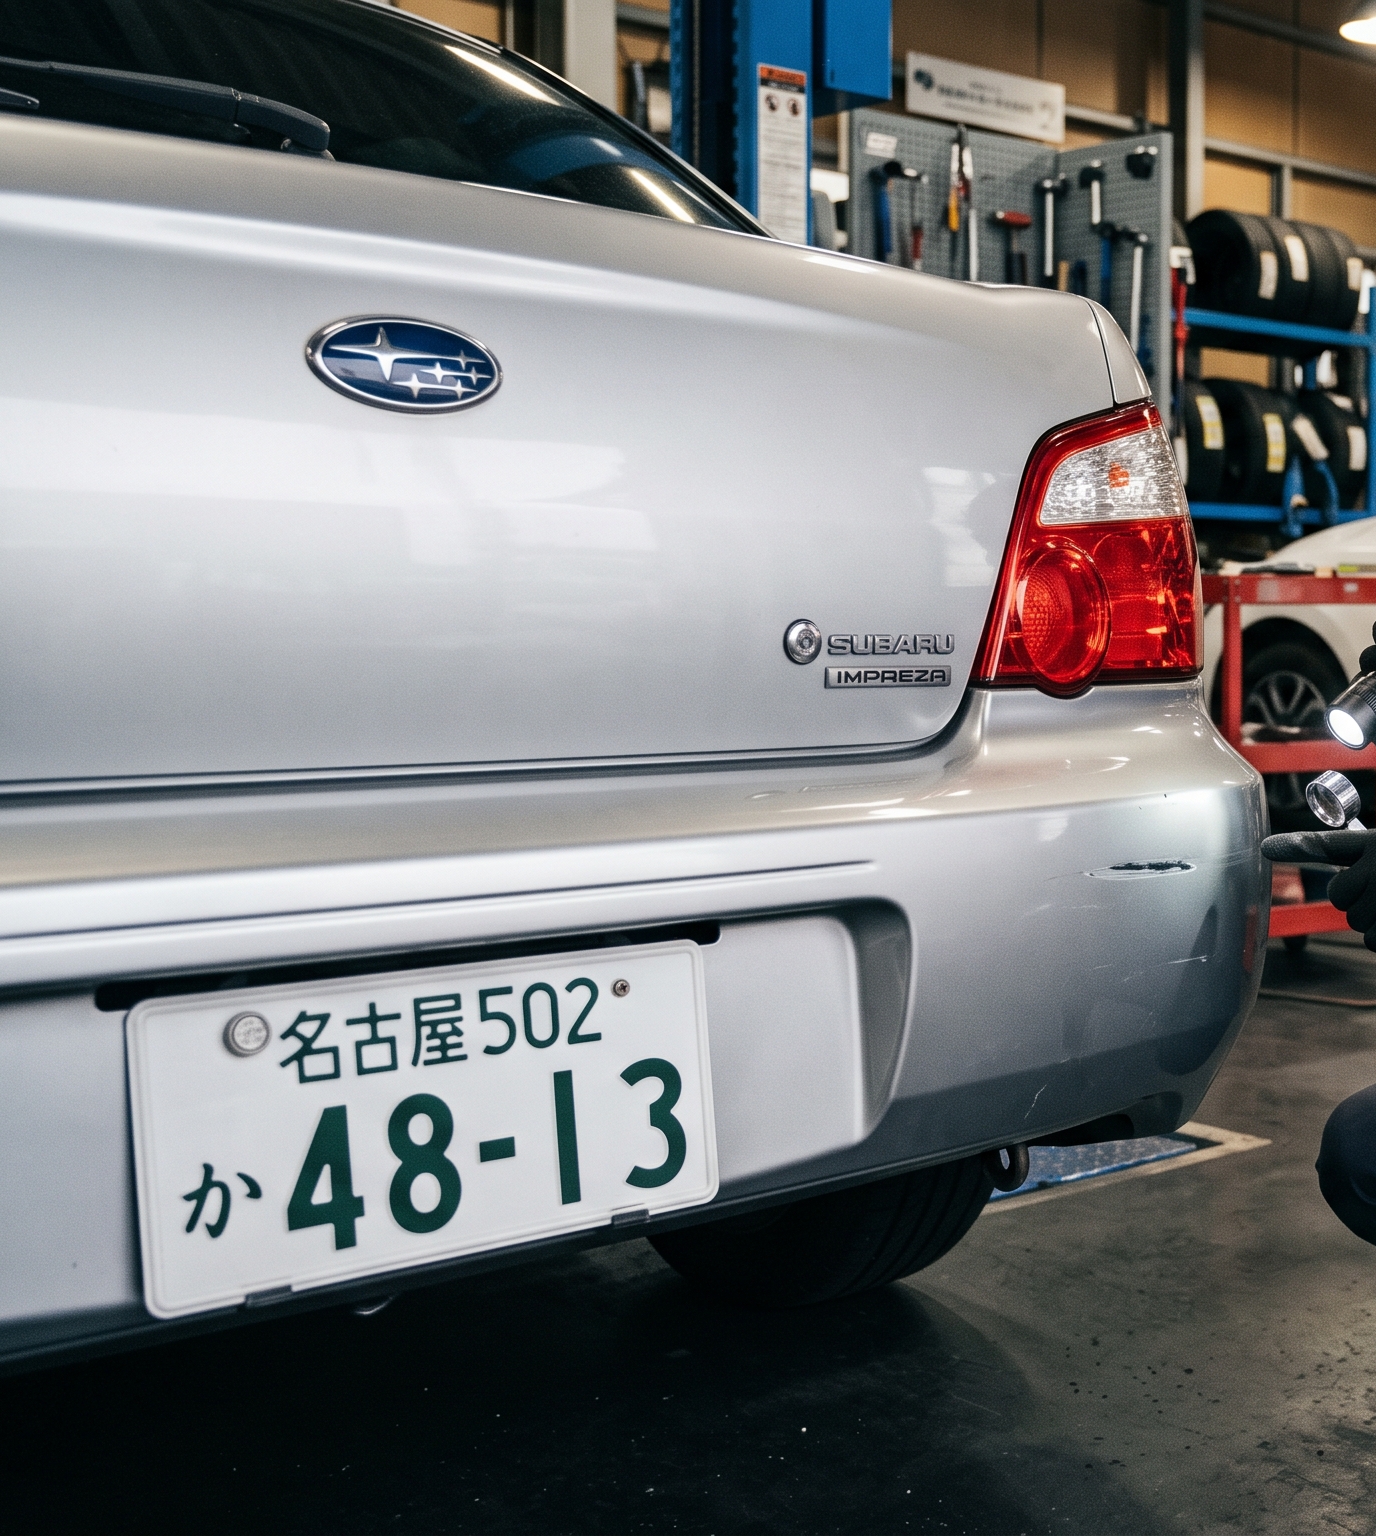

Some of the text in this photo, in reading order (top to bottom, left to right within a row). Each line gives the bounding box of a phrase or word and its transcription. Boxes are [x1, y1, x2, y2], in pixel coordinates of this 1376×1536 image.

[828, 634, 955, 655] SUBARU
[837, 669, 946, 684] IMPREZA
[182, 1056, 688, 1251] か 48-13
